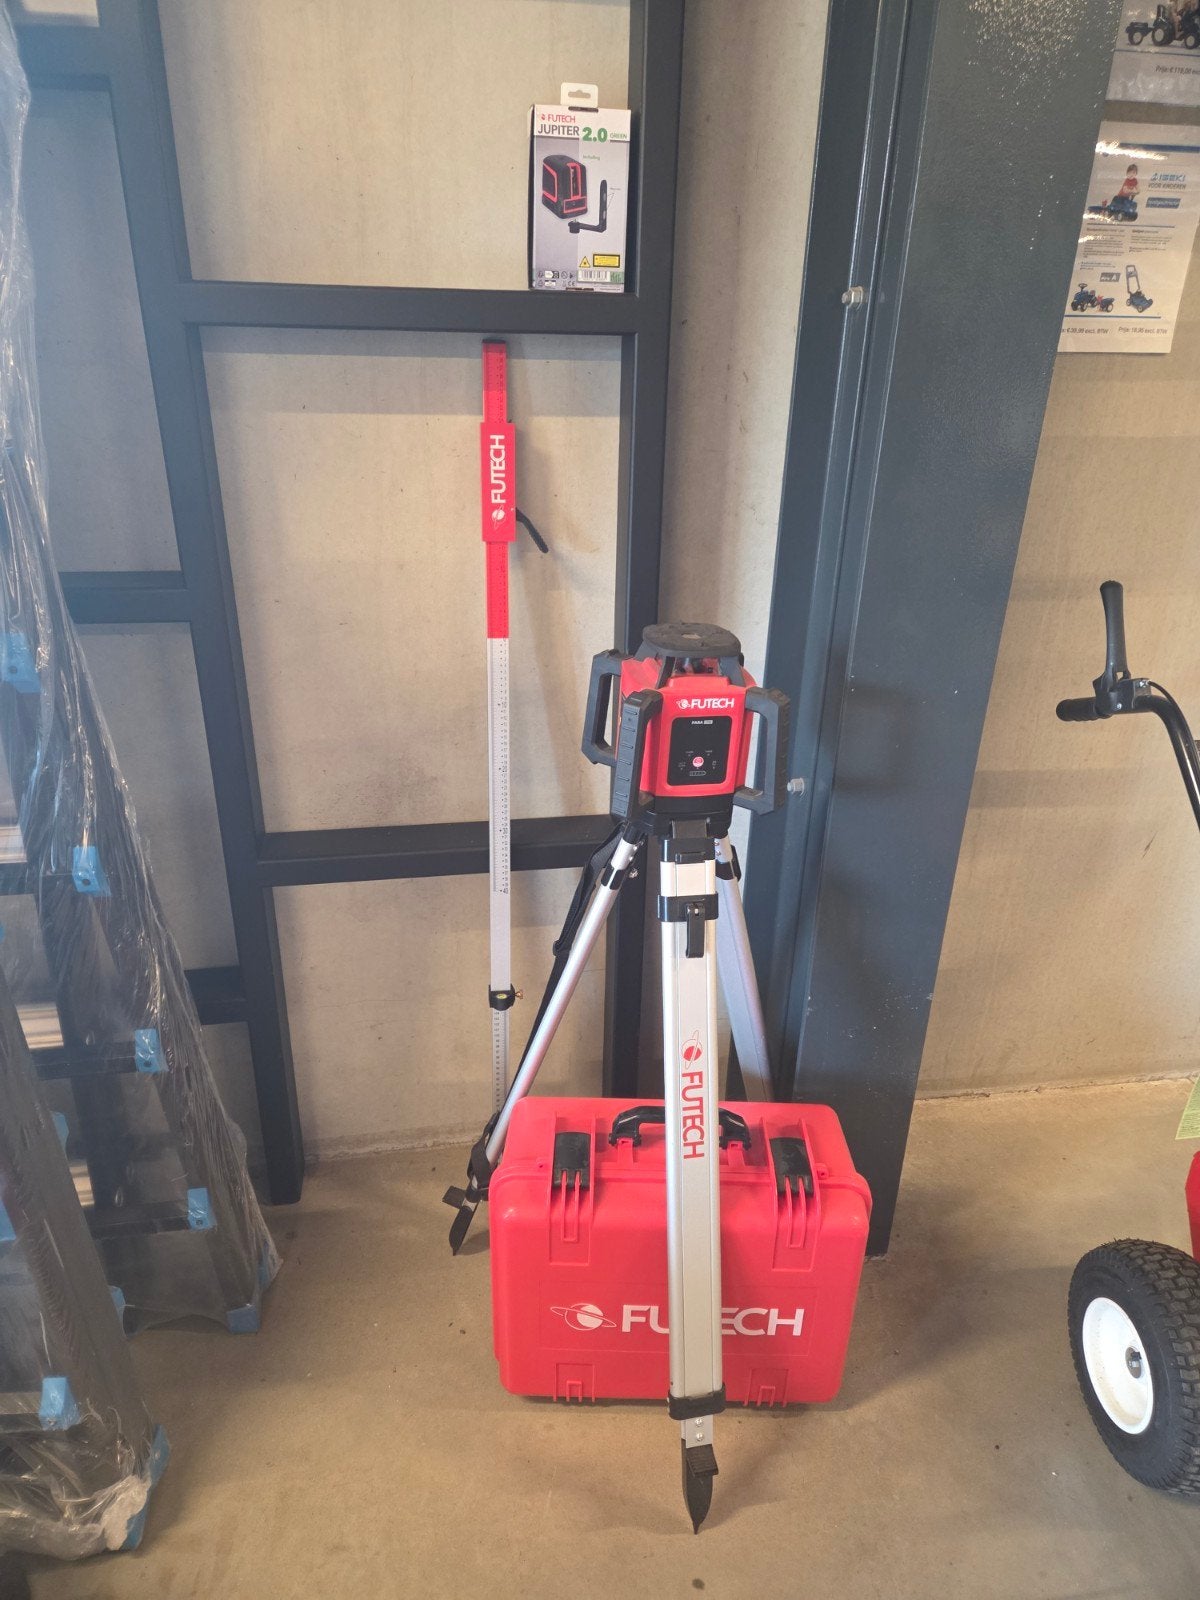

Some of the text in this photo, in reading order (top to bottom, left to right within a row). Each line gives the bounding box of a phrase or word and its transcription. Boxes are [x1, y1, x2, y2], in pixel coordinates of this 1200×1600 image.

[548, 114, 575, 123] FUTECH
[538, 124, 579, 136] JUPITER
[582, 127, 608, 142] 2.0
[490, 434, 506, 504] FUTECH
[691, 698, 734, 709] FUTECH
[682, 1071, 705, 1160] FUTECH
[622, 1304, 804, 1336] FUECH
